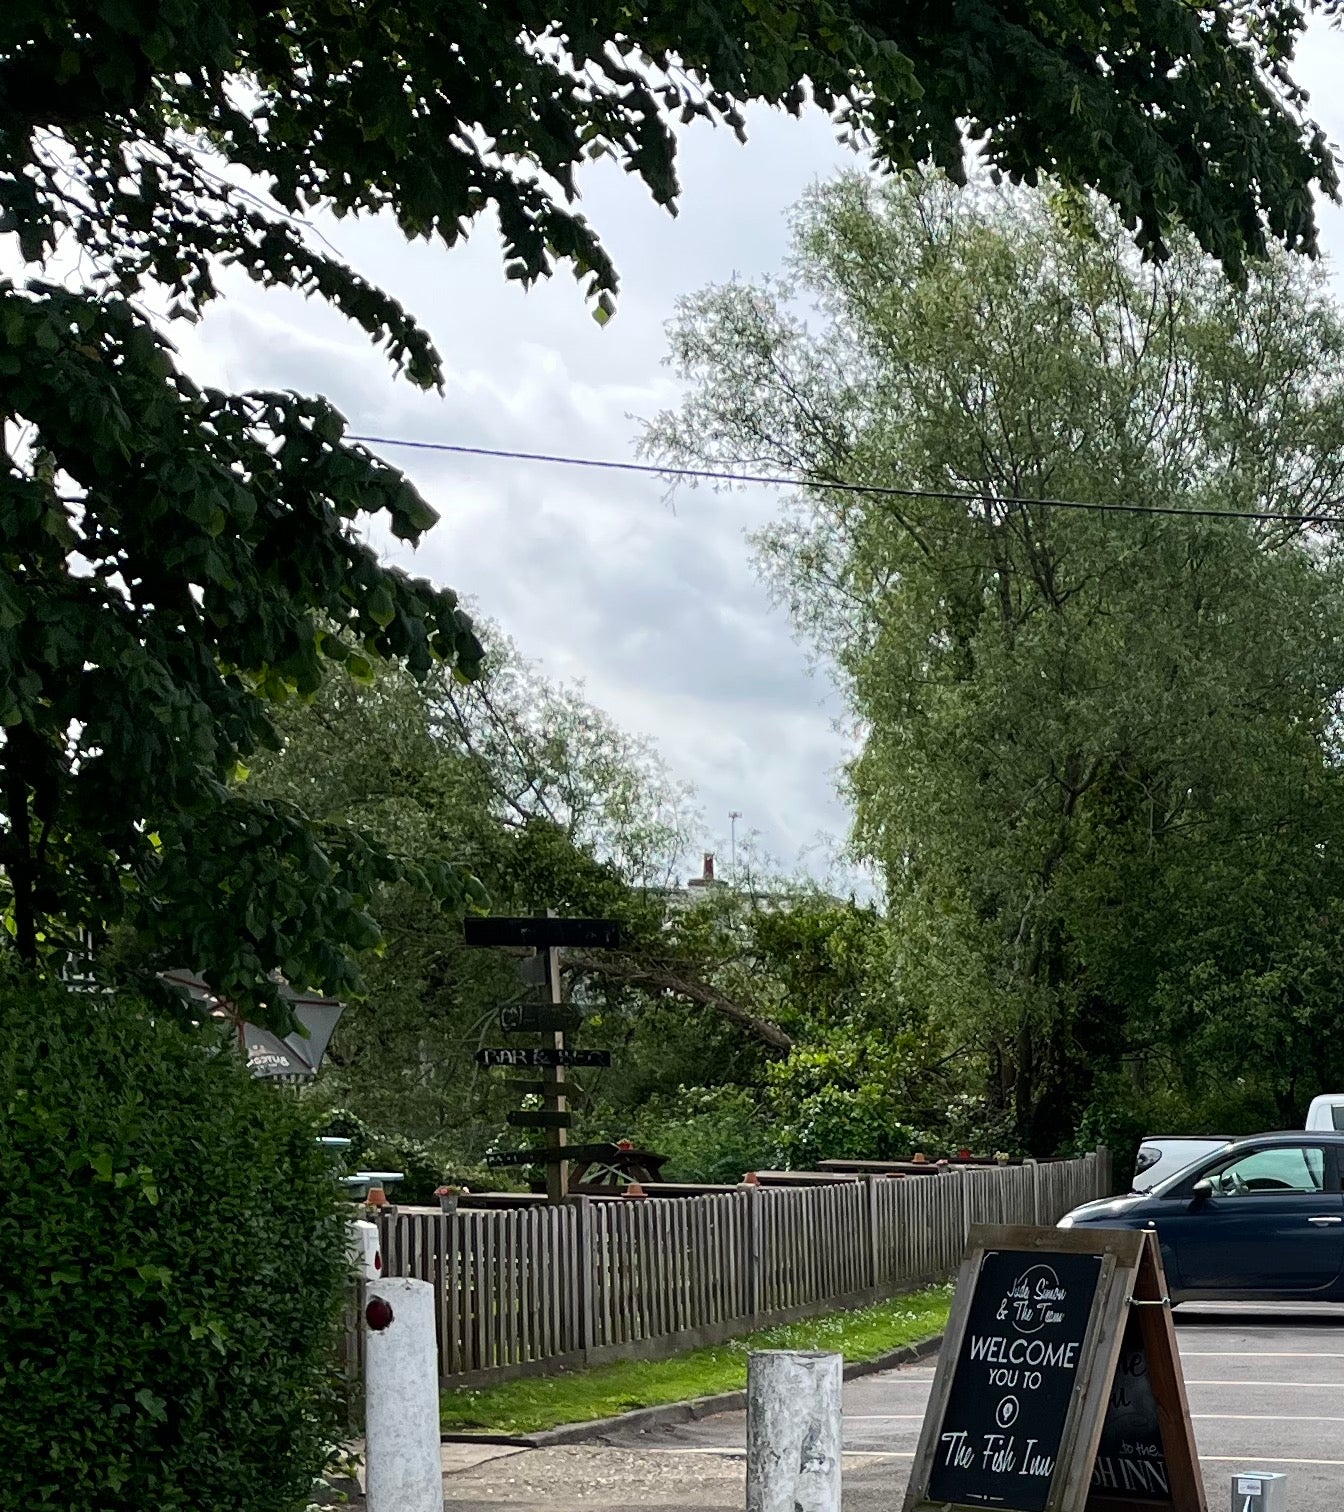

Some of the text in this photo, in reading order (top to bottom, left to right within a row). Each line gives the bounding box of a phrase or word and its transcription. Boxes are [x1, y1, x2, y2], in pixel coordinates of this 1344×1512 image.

[1033, 1277, 1067, 1301] Simon
[996, 1297, 1066, 1323] & The Team
[970, 1335, 1079, 1369] WELCOME
[988, 1368, 1042, 1390] YOU TO
[941, 1430, 1055, 1477] The Fish Inn
[1118, 1458, 1169, 1494] INN
